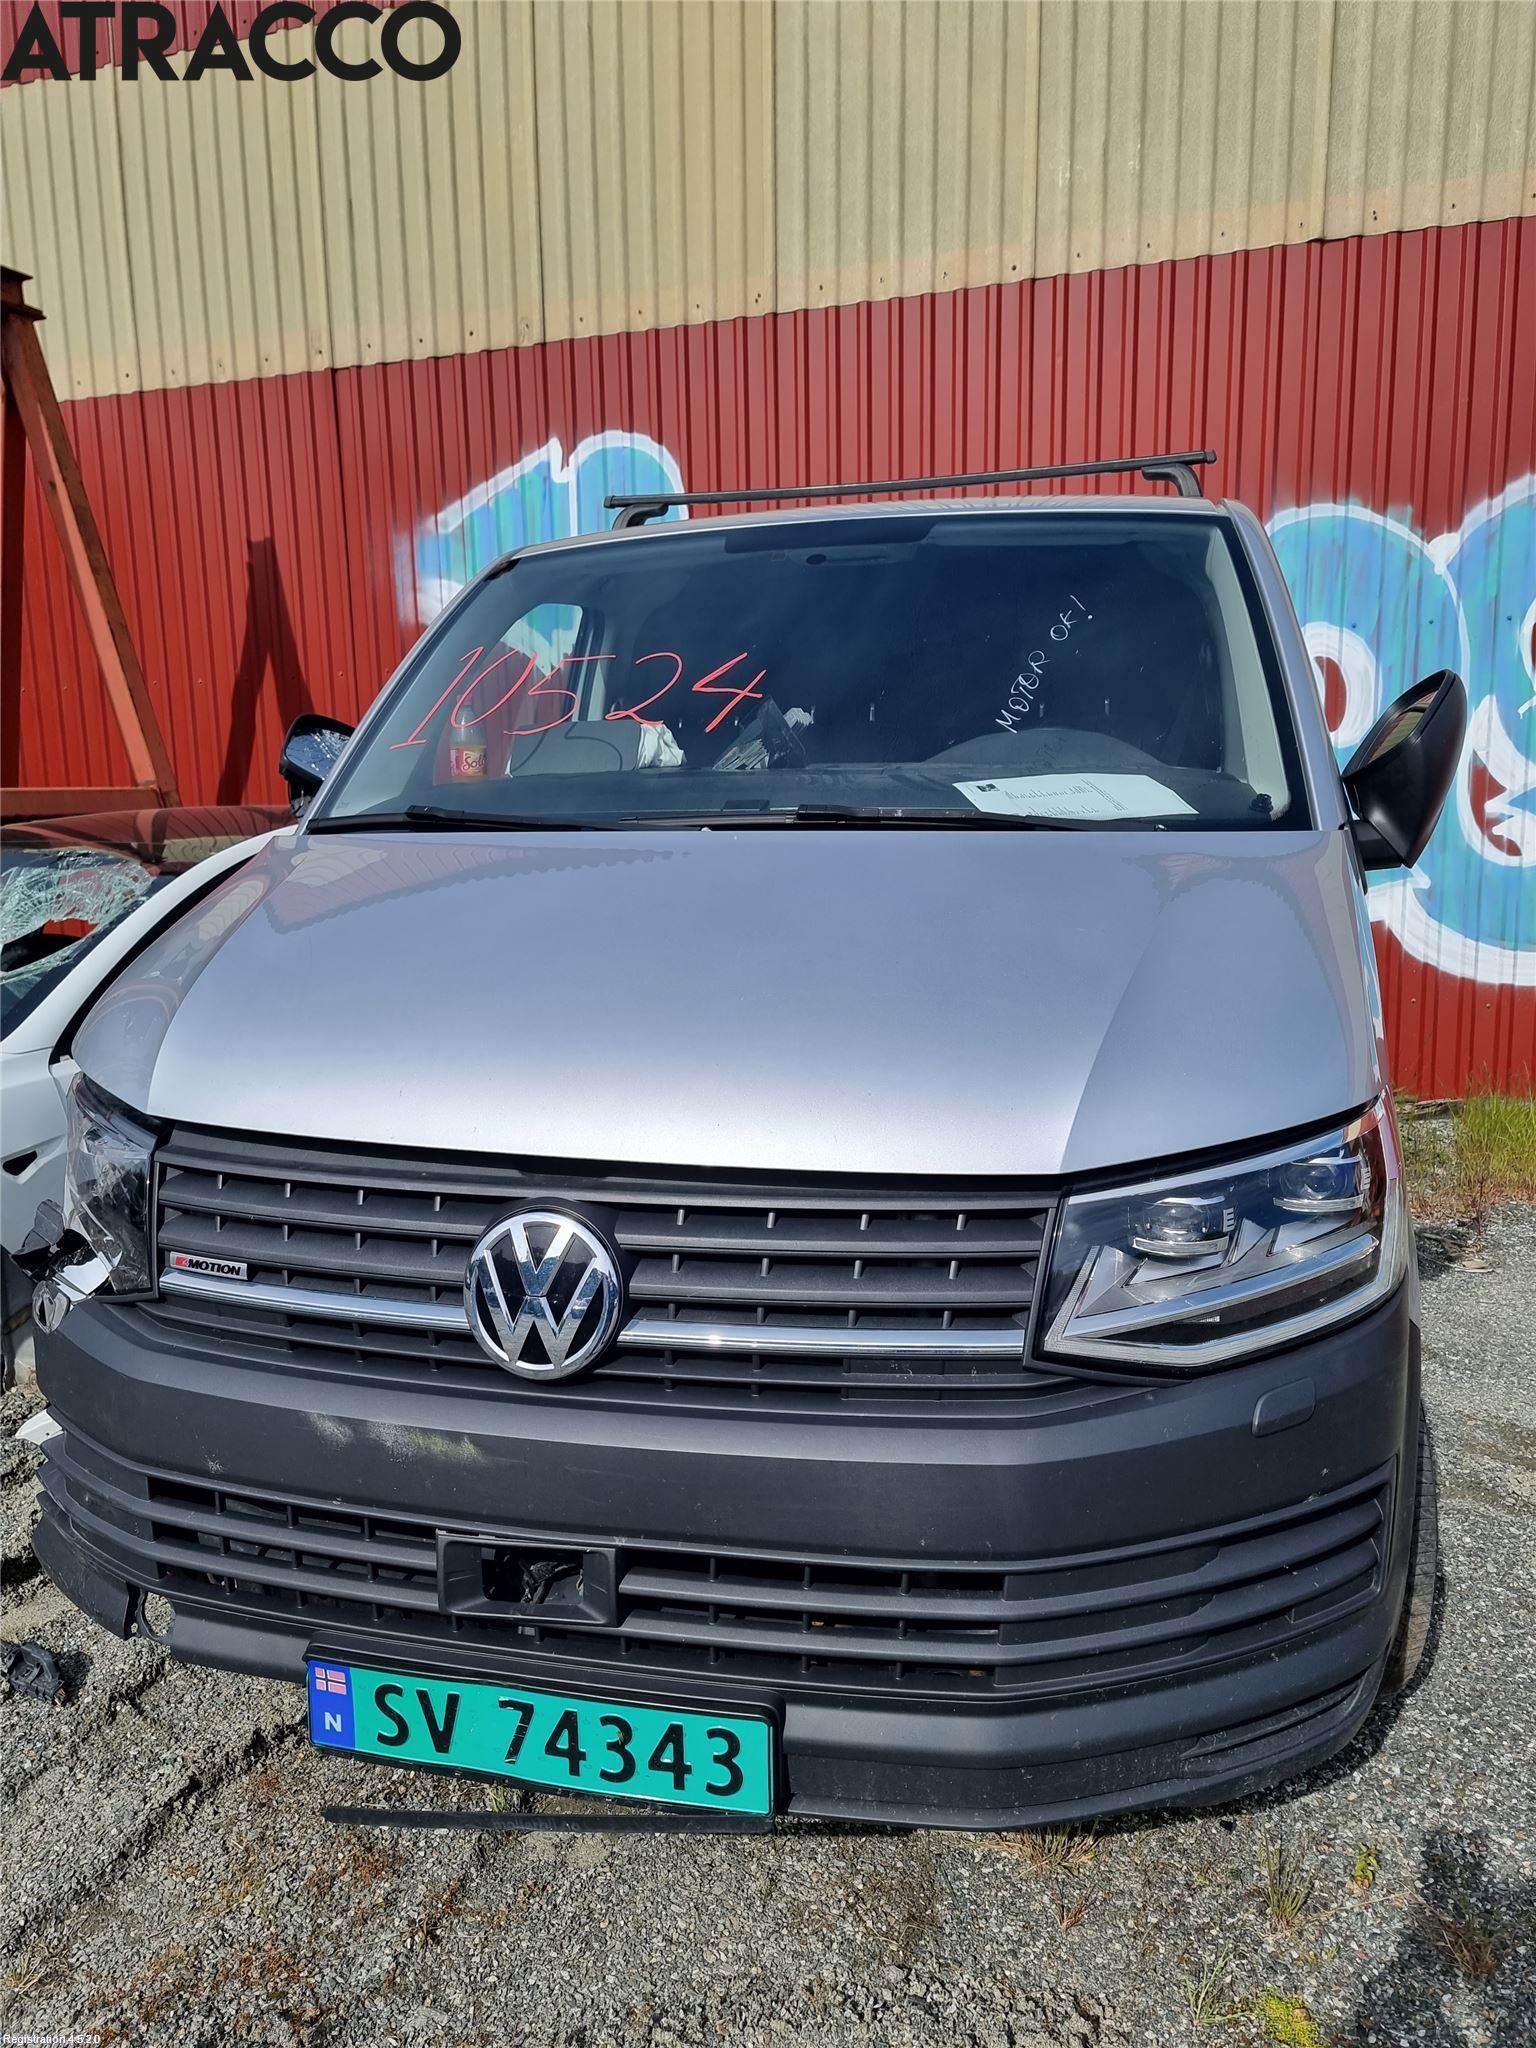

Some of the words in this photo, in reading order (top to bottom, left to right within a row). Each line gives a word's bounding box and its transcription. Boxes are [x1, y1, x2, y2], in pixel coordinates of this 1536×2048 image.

[390, 646, 767, 750] 10524
[995, 650, 1051, 734] MOTOR
[1050, 595, 1094, 641] OK!
[470, 1215, 613, 1377] VW
[324, 1711, 342, 1733] N
[373, 1683, 460, 1754] SV
[498, 1698, 744, 1797] 74343
